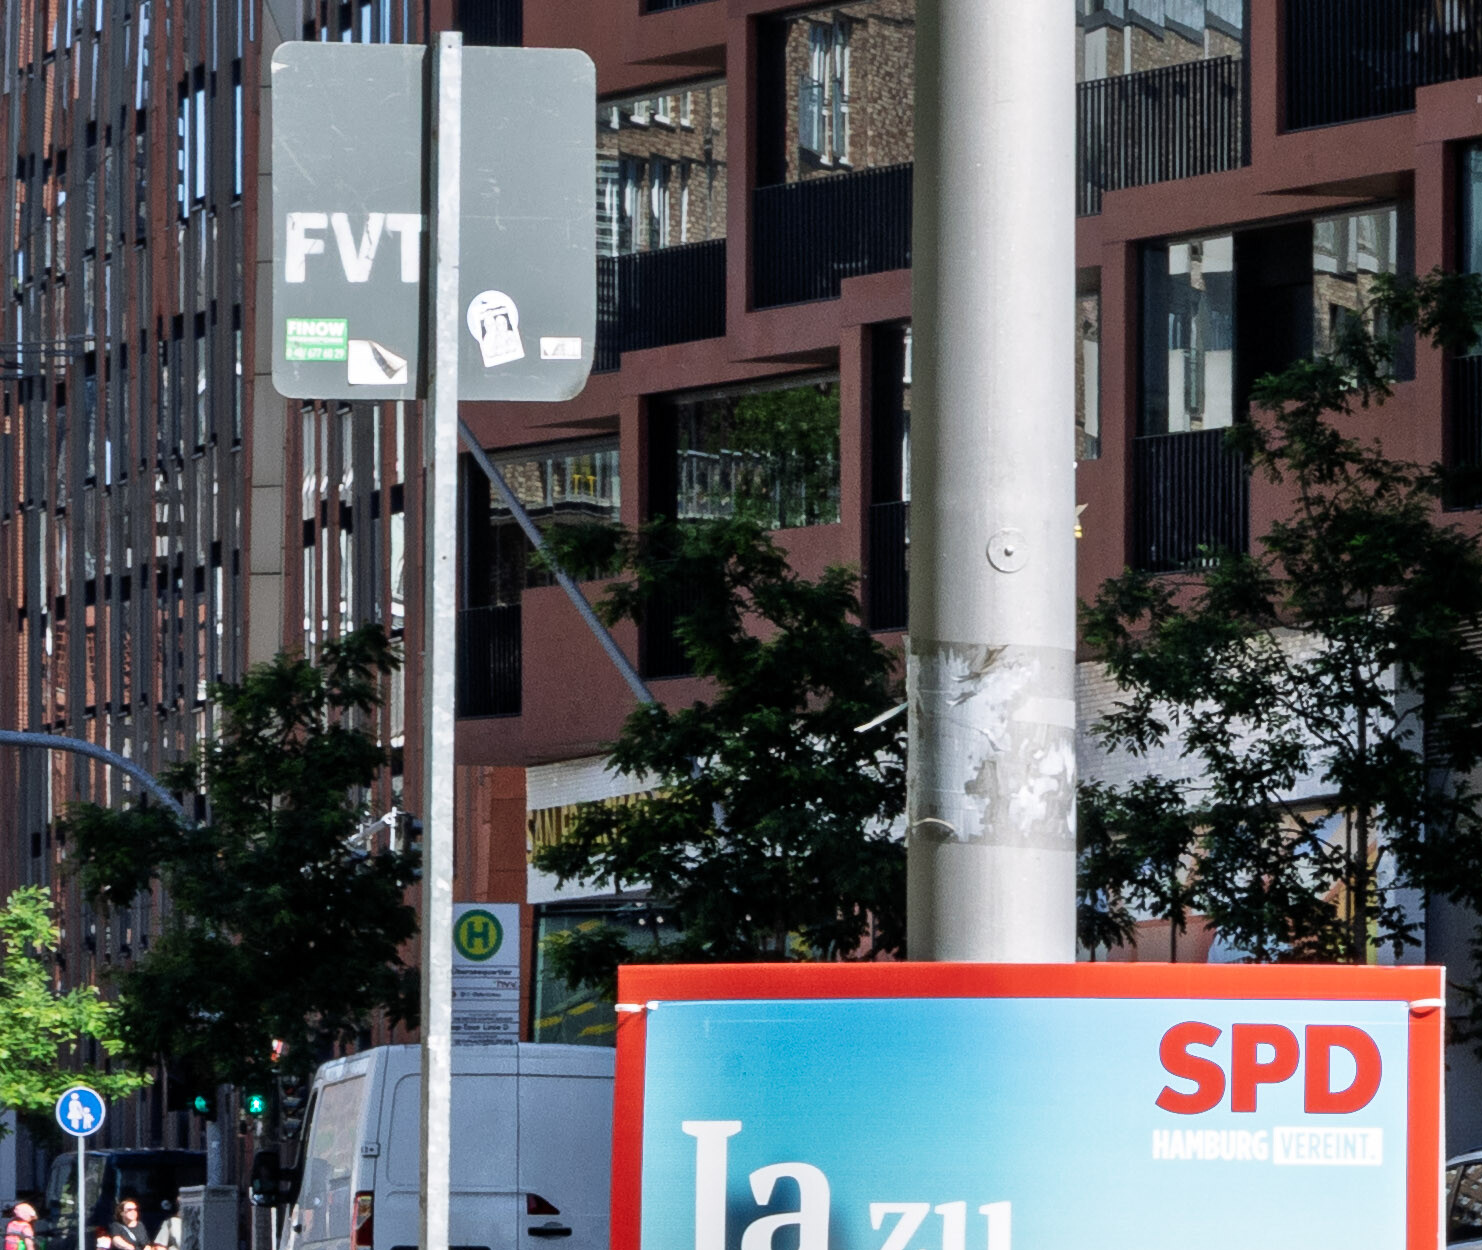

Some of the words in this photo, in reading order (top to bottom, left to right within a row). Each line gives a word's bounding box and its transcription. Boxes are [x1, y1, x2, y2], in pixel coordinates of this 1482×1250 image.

[284, 212, 423, 284] FVT
[286, 320, 346, 337] FINOW
[1155, 1020, 1383, 1116] SPD
[1151, 1129, 1270, 1163] HAMBURG
[1280, 1132, 1377, 1161] VEREINT.
